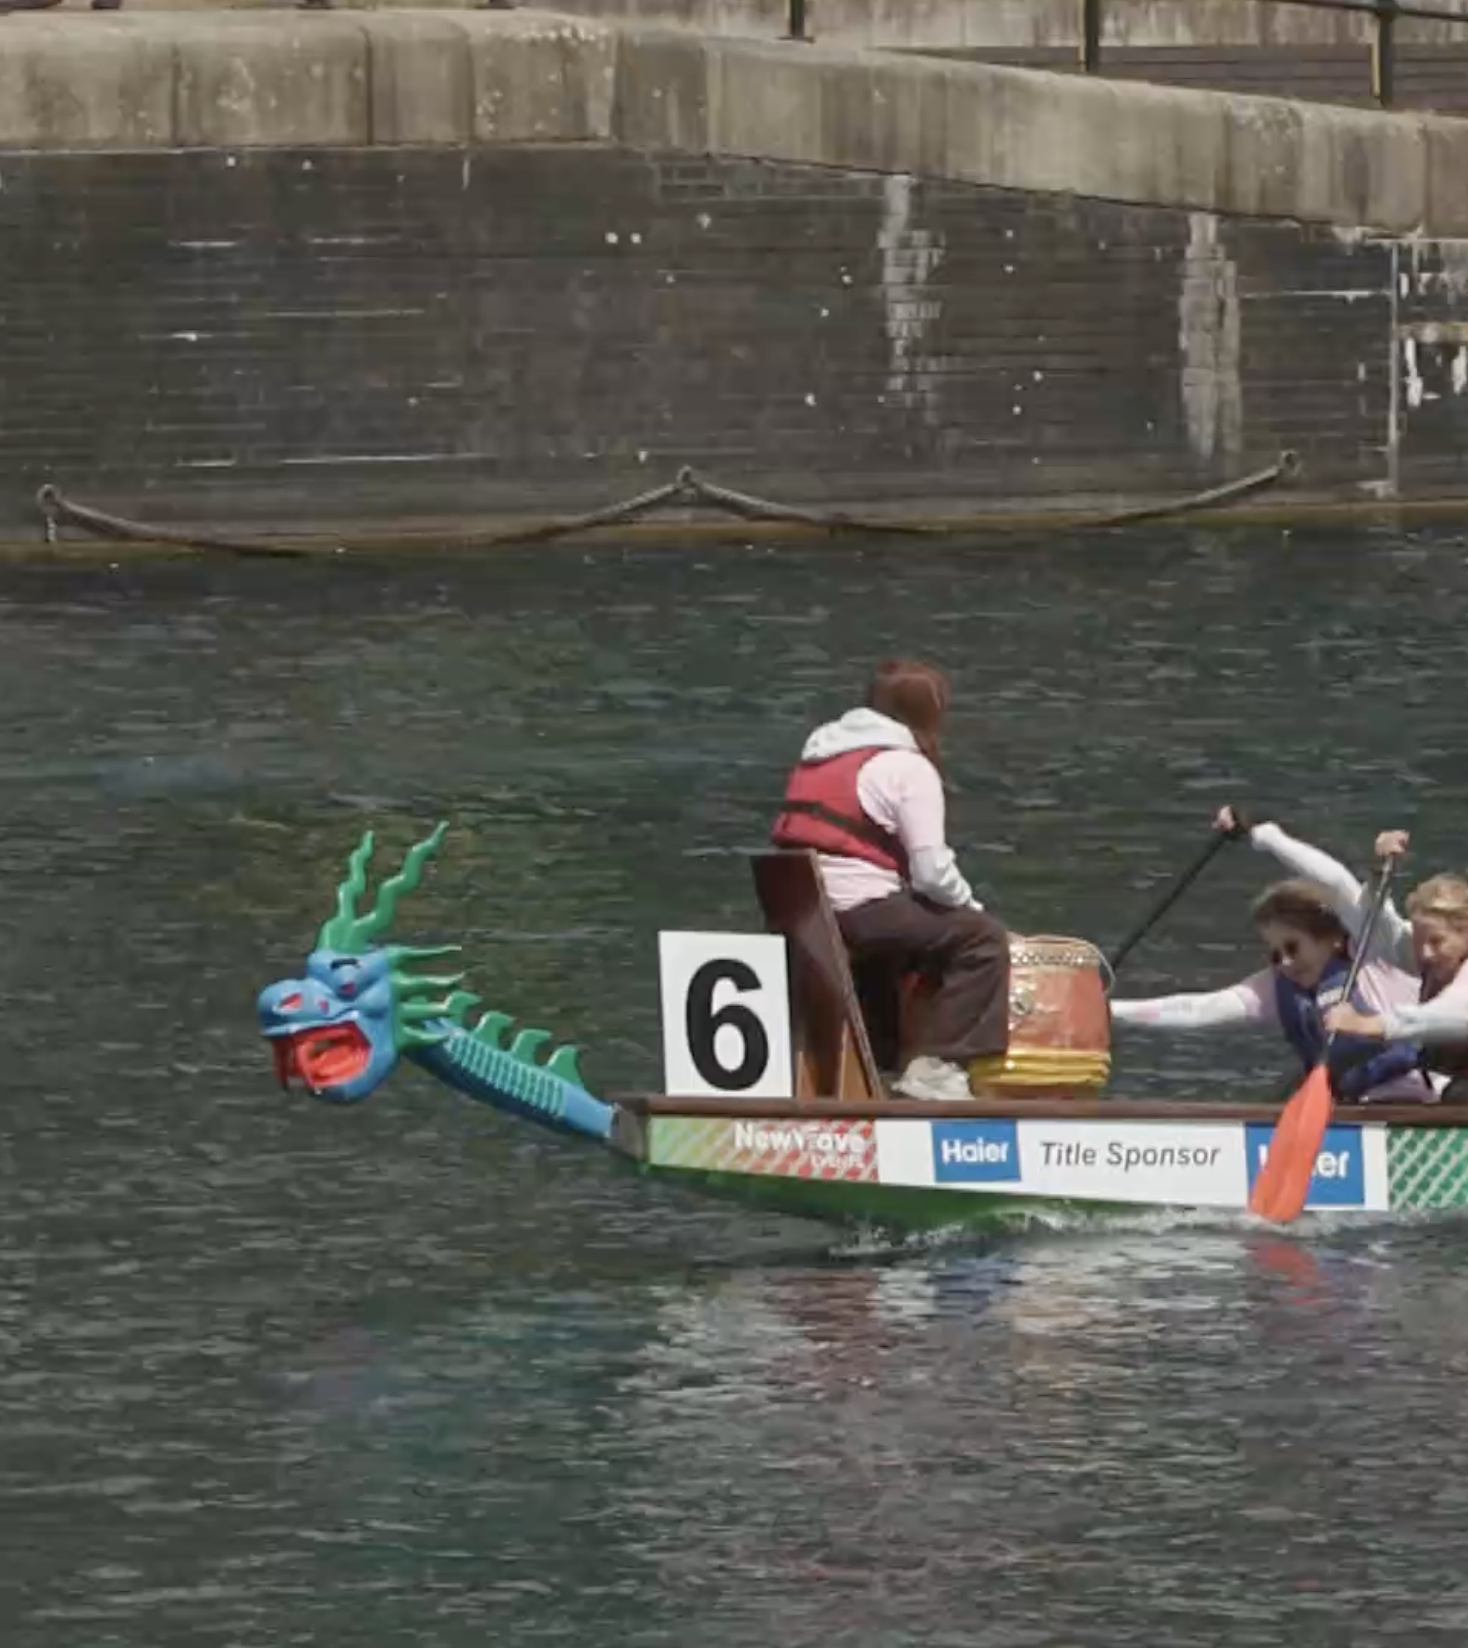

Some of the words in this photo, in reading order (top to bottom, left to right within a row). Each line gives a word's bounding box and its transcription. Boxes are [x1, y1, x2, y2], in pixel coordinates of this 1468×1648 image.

[685, 958, 769, 1091] 6
[941, 1138, 1009, 1164] Haier
[1040, 1141, 1097, 1166] Title
[1105, 1142, 1220, 1172] Sponsor
